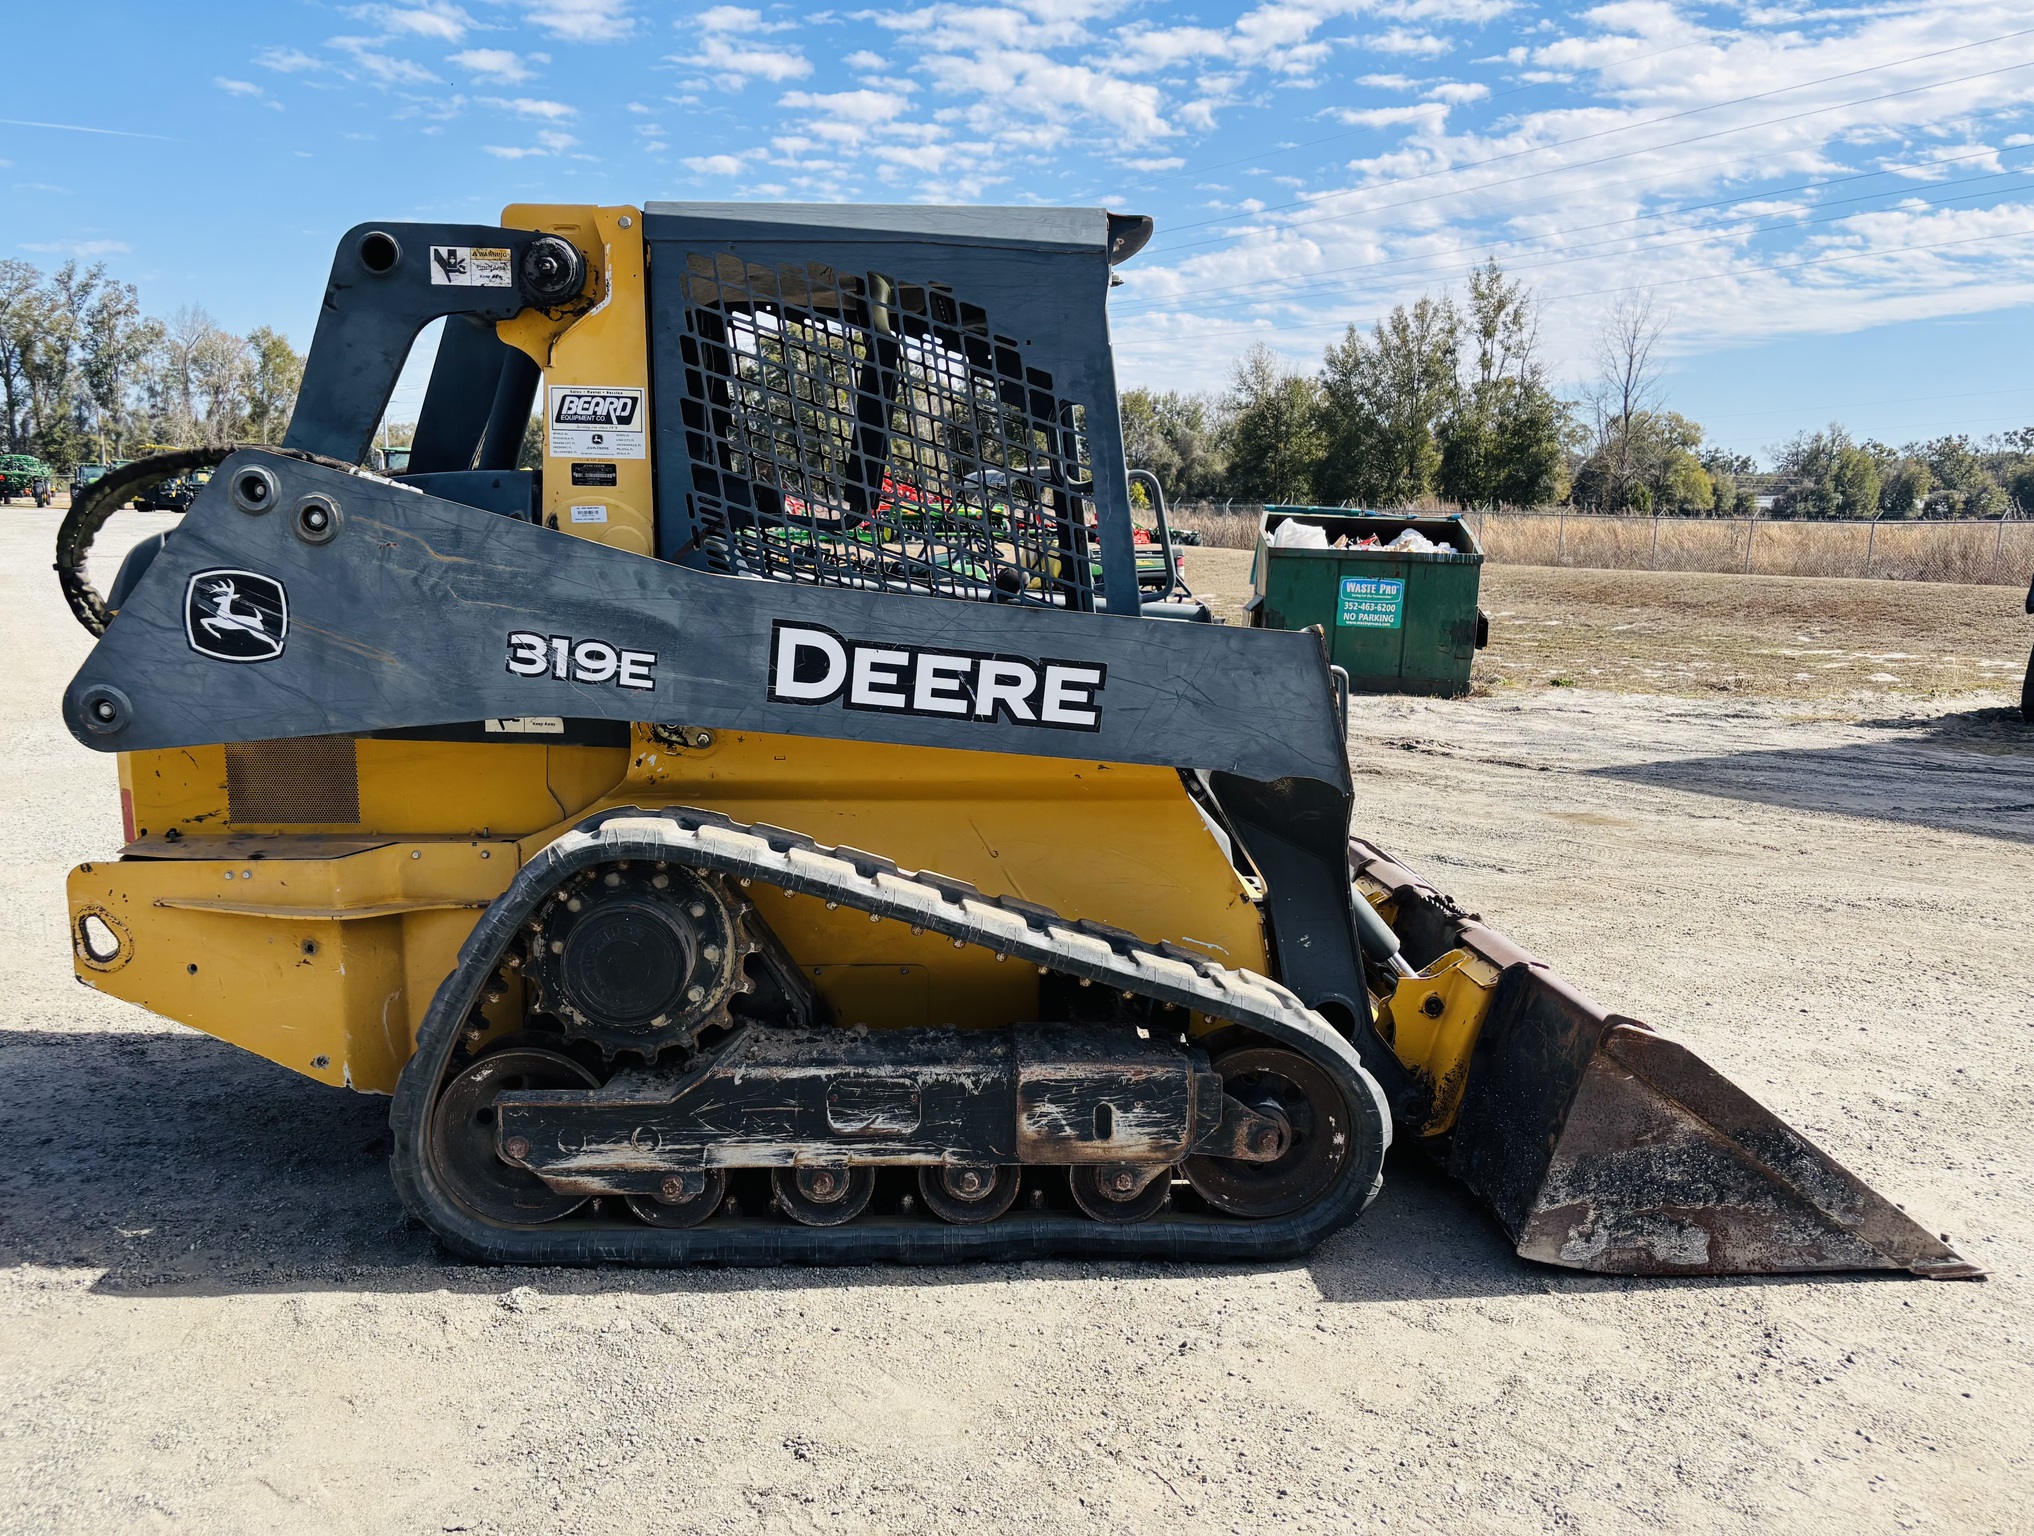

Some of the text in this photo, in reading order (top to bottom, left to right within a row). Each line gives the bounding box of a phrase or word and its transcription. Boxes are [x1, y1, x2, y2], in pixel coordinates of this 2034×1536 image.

[561, 396, 632, 425] BEARD
[1346, 582, 1397, 595] WASTE PRO
[1344, 601, 1396, 612] 352-463-6200
[1343, 612, 1395, 623] NO PARKING
[507, 632, 657, 690] 319E
[773, 624, 1103, 729] DEERE
